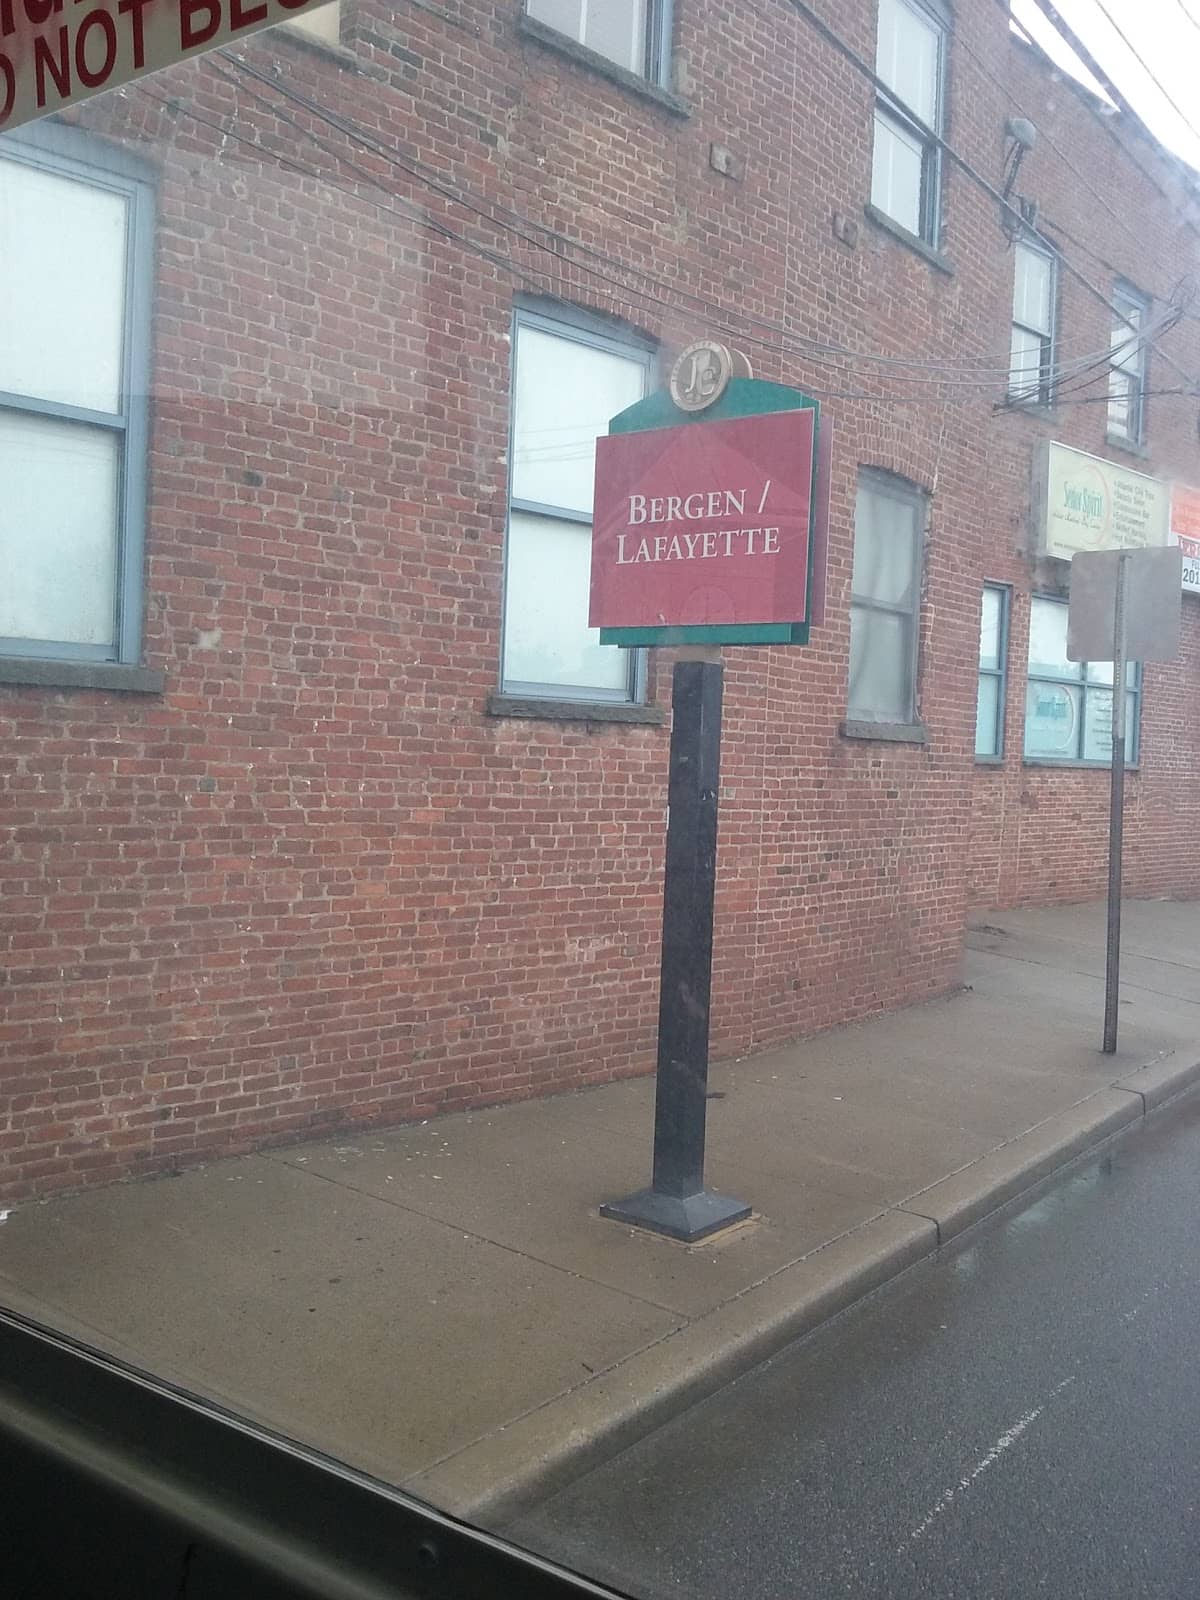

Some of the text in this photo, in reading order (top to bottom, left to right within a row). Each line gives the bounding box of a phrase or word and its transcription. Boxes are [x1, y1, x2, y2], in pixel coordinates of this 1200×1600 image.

[34, 0, 151, 108] NOT
[628, 480, 771, 525] BERGEN /
[615, 527, 781, 564] LAFAYETTE
